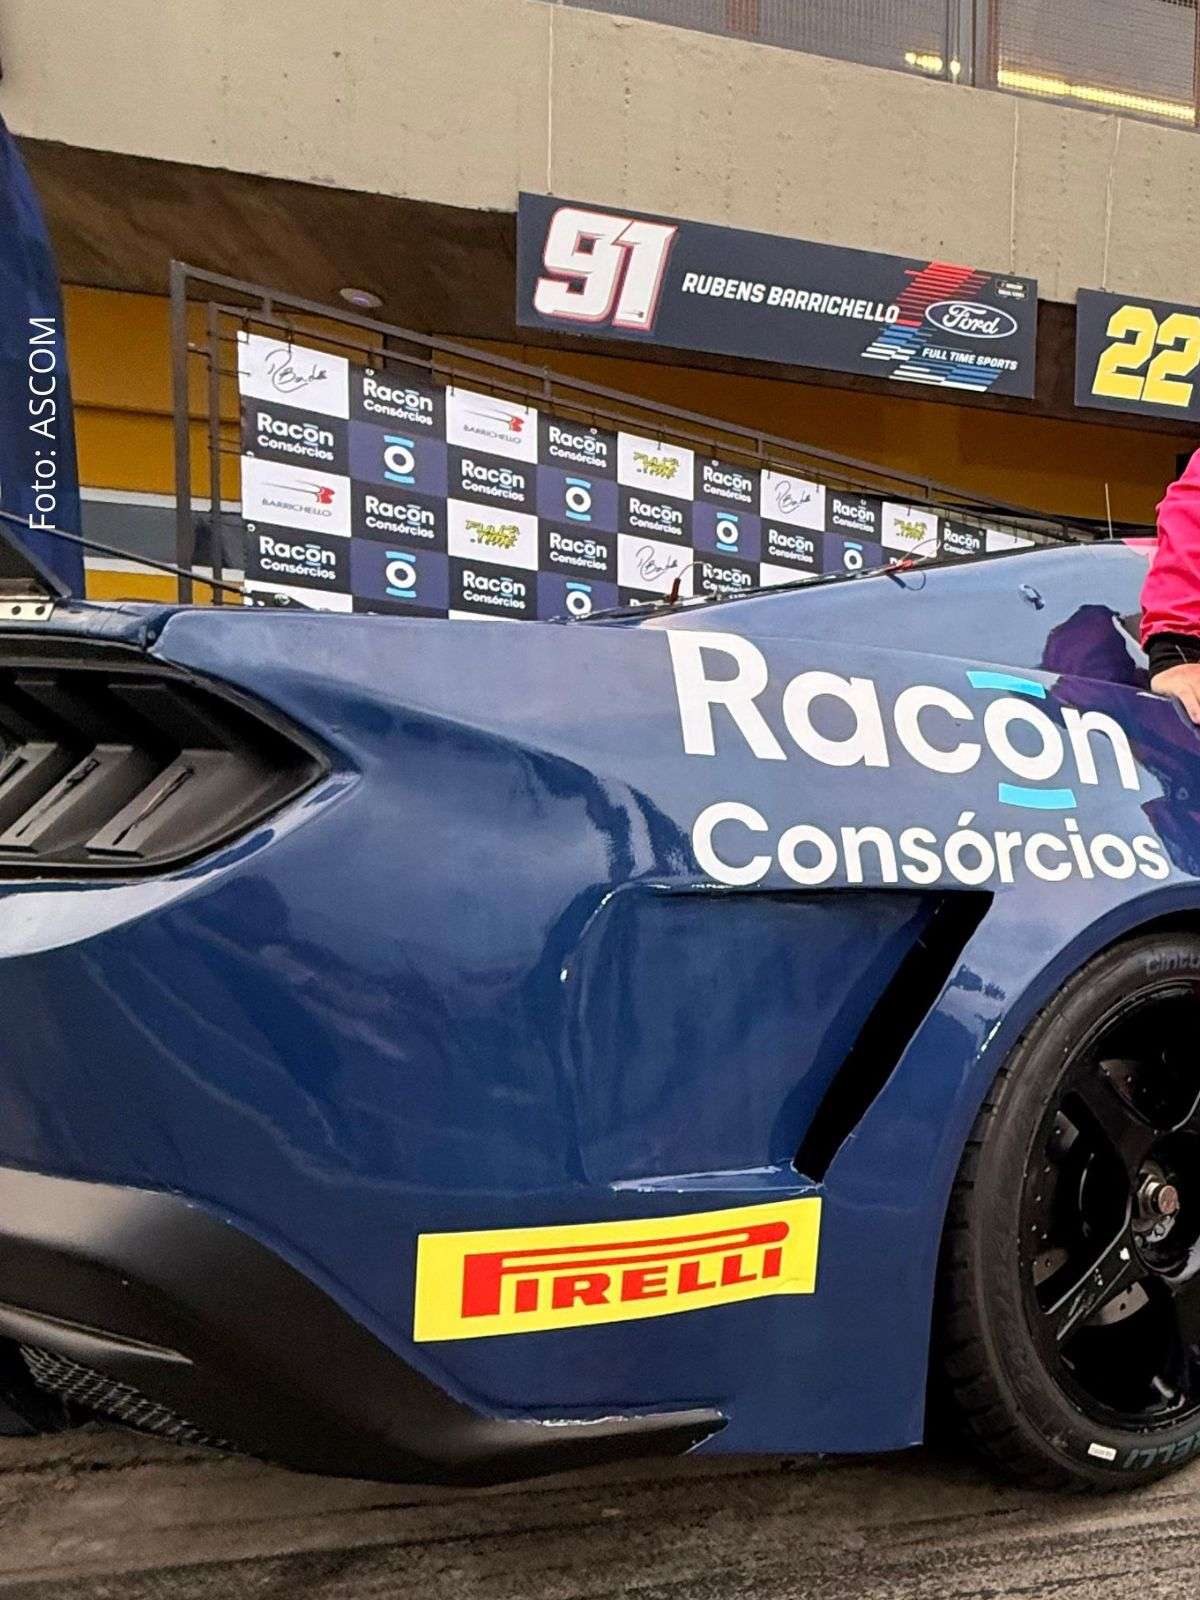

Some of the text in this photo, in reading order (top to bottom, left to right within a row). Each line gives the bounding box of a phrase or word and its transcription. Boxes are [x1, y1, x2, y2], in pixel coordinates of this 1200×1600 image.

[533, 207, 680, 331] 91
[682, 272, 900, 324] RUBENS BARRICHELLO
[942, 304, 1001, 334] Ford
[922, 347, 1019, 371] FULL TIME SPORTS
[363, 377, 433, 412] Racon
[257, 414, 334, 447] Racon
[549, 426, 607, 455] Racon
[461, 459, 525, 489] Racon
[703, 466, 752, 492] Racon
[365, 495, 435, 525] Racon
[629, 498, 682, 524] Racon
[833, 498, 875, 522] Racon
[259, 537, 336, 566] Racon
[549, 533, 607, 558] Racon
[769, 529, 814, 553] Racon
[463, 570, 525, 598] Racon
[666, 629, 1141, 790] Racon
[691, 801, 1171, 886] Consórcios
[461, 1221, 789, 1319] PIRELLI
